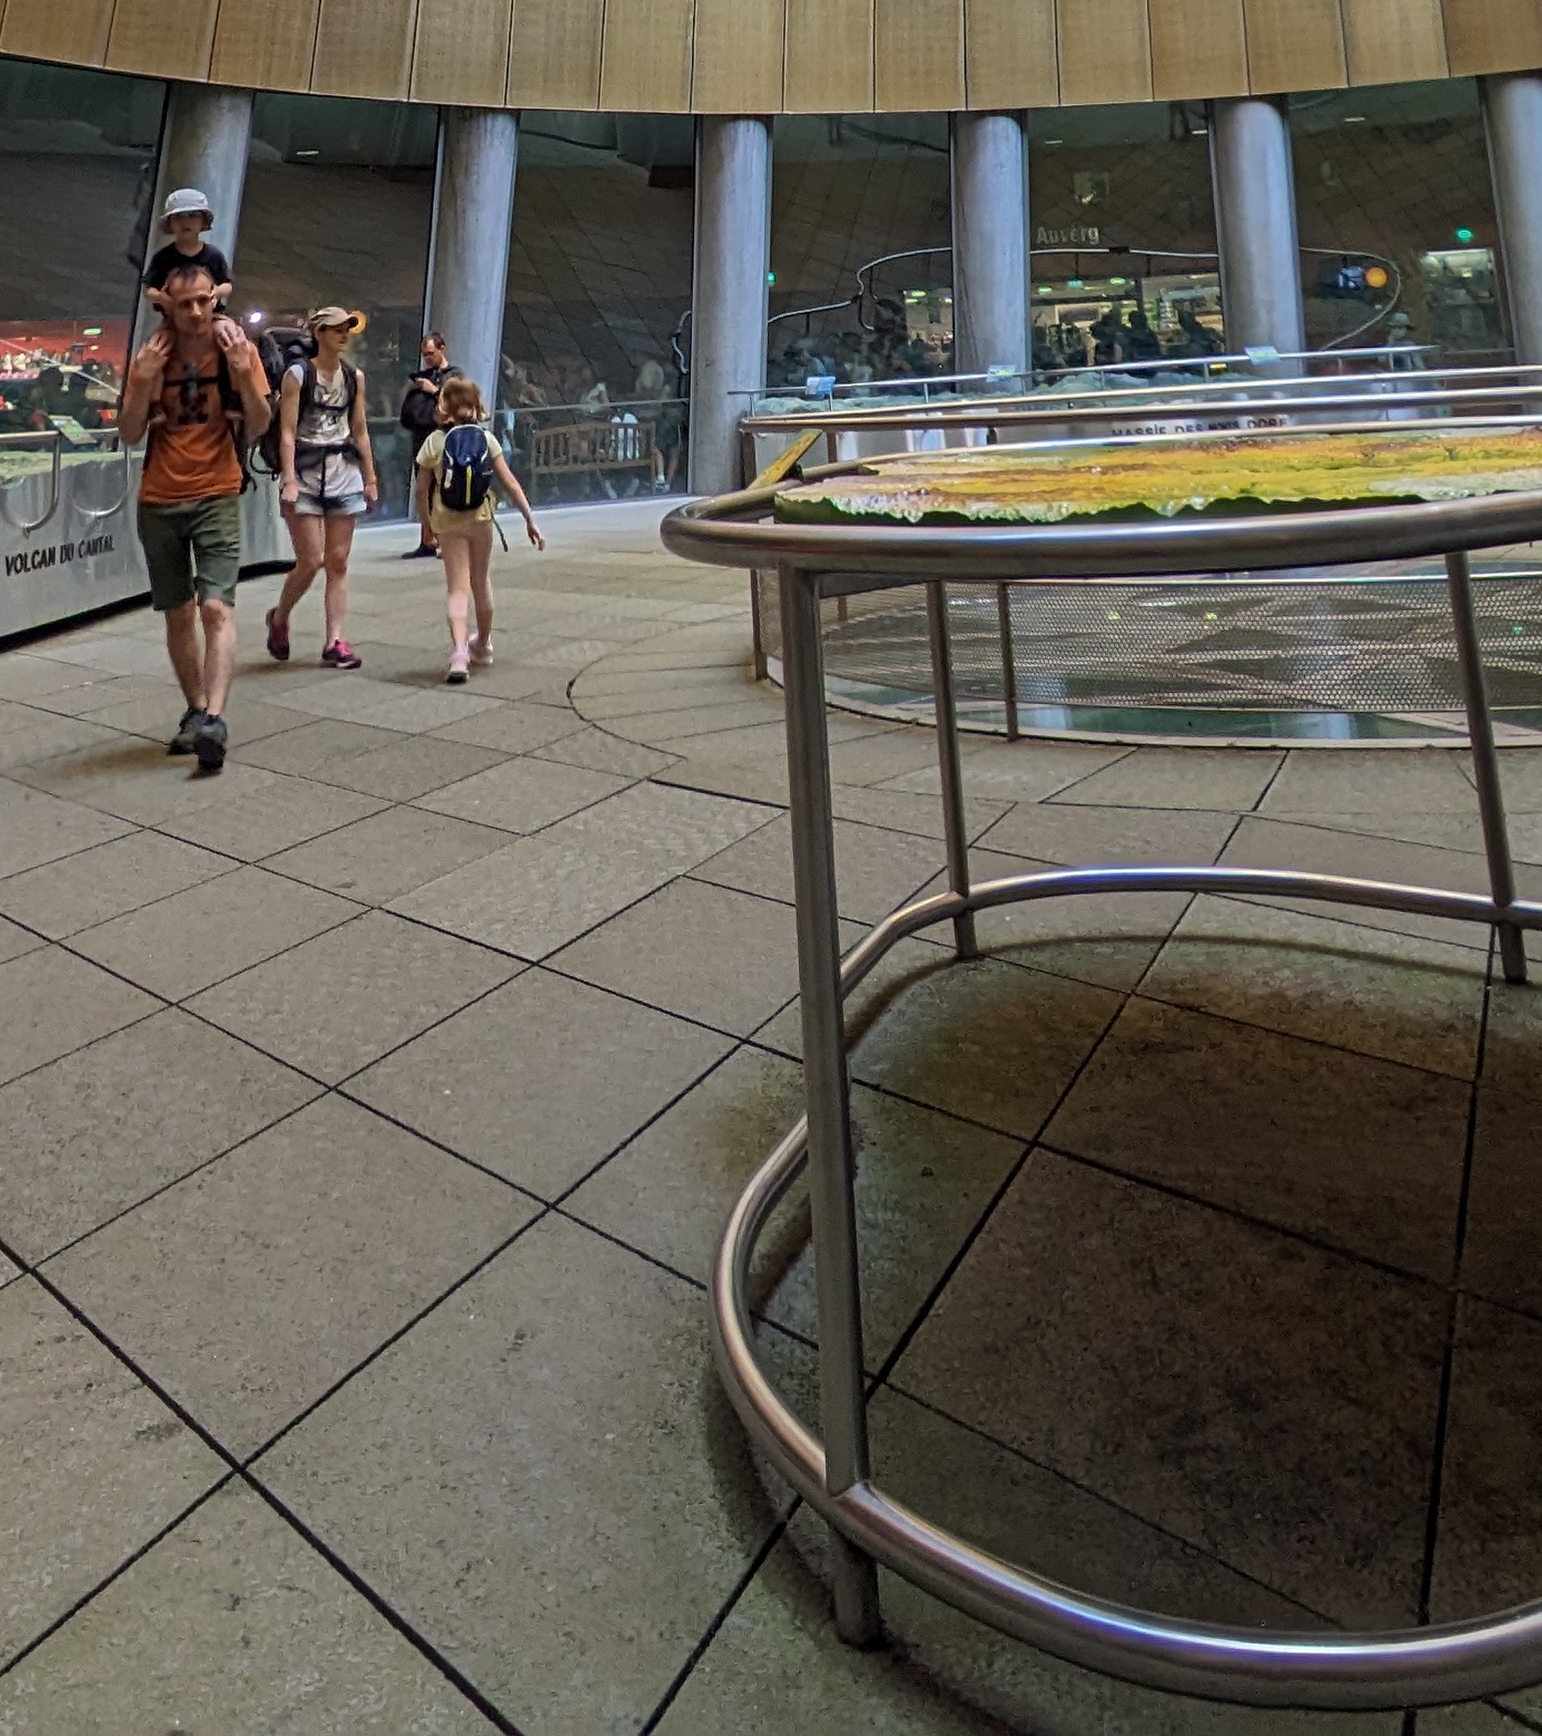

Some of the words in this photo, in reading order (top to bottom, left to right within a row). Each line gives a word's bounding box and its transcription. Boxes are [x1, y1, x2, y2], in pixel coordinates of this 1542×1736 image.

[5, 546, 56, 577] VOLCAN
[60, 543, 74, 564] DU
[79, 535, 115, 558] CANTAL
